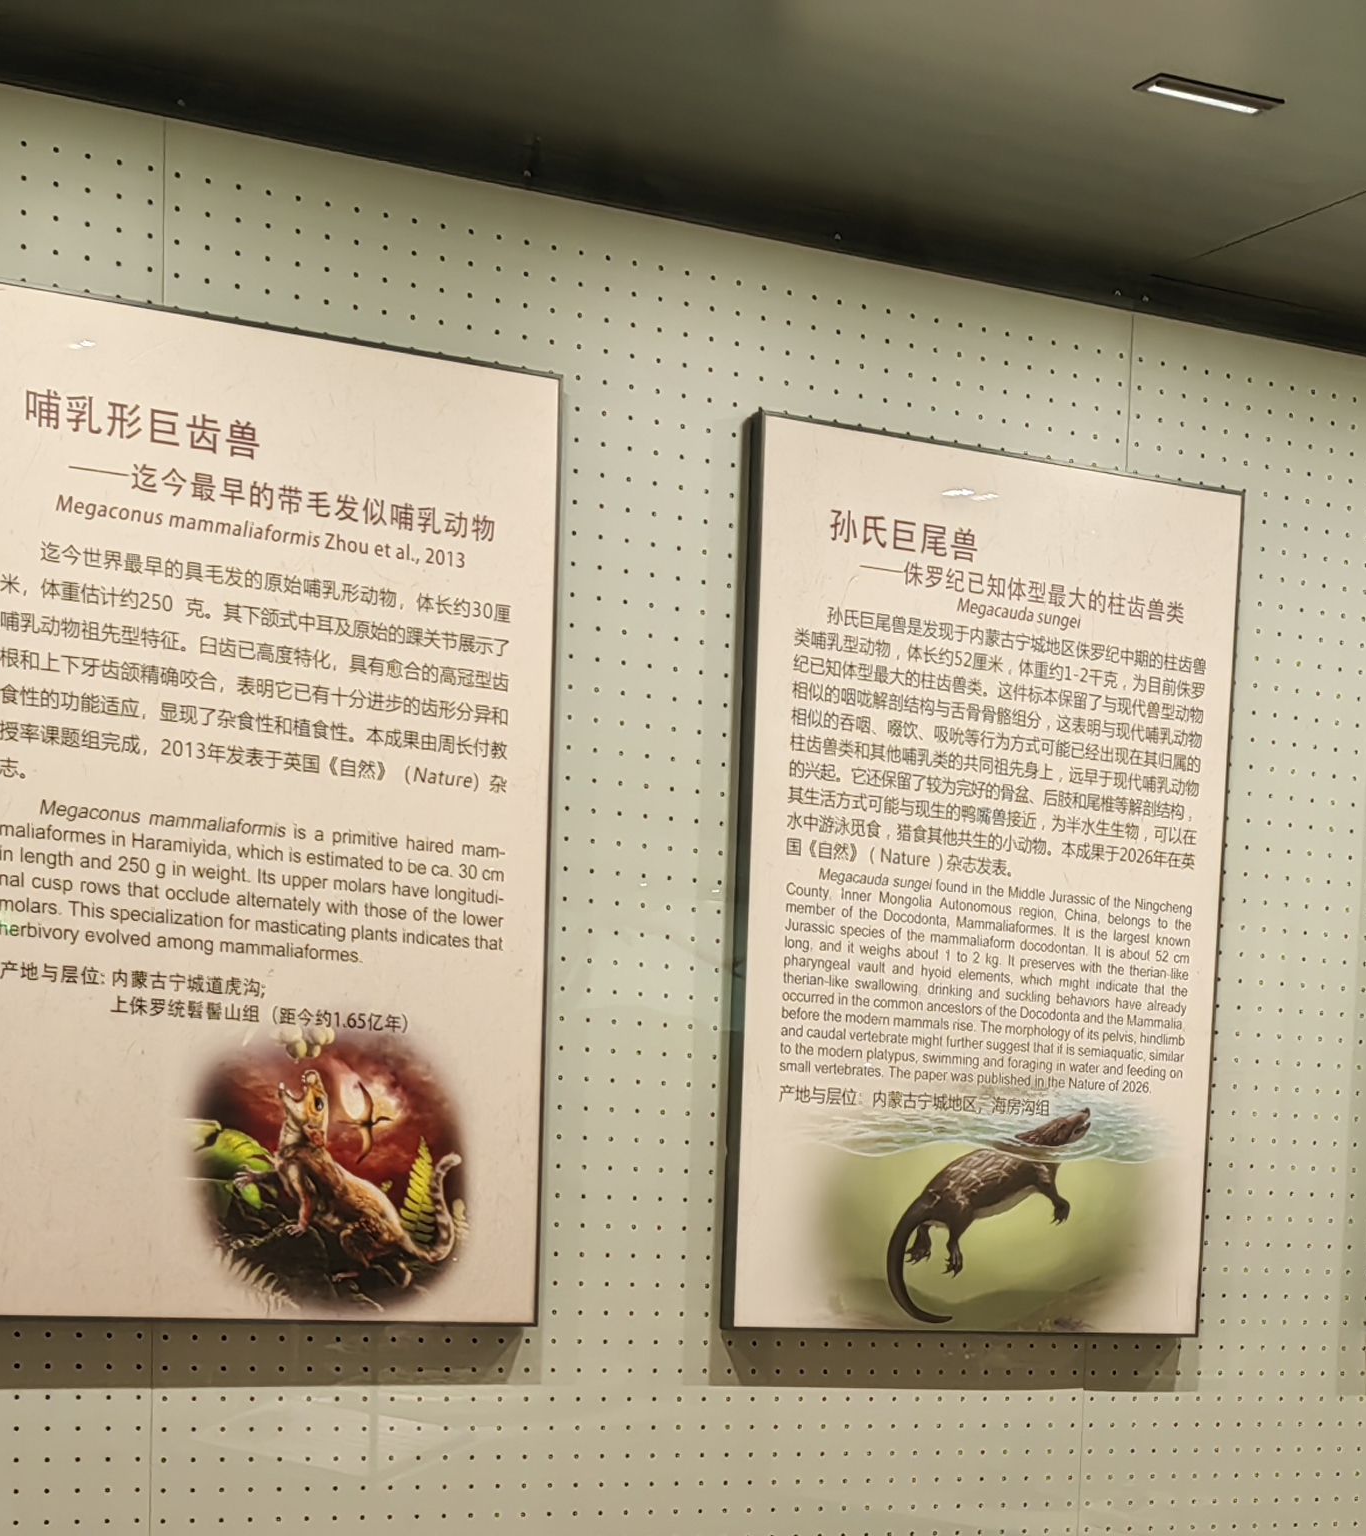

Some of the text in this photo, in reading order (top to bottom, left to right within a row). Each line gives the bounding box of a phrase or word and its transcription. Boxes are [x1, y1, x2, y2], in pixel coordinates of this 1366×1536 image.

[25, 388, 261, 461] 哺乳形巨齿兽
[55, 494, 466, 569] Megaconus mammaliaformis Zhou et al., 2013
[829, 508, 978, 563] 孙氏巨尾兽
[956, 597, 1082, 632] Megacauda sungei
[39, 798, 506, 859] Megaconus mammaliaformis is a primitive haired mam-
[20, 846, 74, 870] length
[79, 854, 112, 871] and
[117, 855, 150, 874] 250
[155, 862, 166, 880] g
[172, 860, 187, 877] in
[191, 864, 251, 885] weight.
[257, 867, 276, 886] Its
[281, 874, 329, 892] upper
[333, 877, 387, 895] molars
[391, 880, 430, 899] have
[434, 884, 505, 906] longitudi-
[818, 866, 1193, 918] Megacauda sungei found in the Middle Jurassic of the Ningcheng
[112, 968, 266, 999] 内蒙古宁城道虎沟;
[781, 1005, 820, 1022] before
[823, 1009, 842, 1023] the
[845, 1011, 890, 1026] modern
[892, 1016, 950, 1031] mammals
[980, 1019, 1003, 1035] The
[1004, 1023, 1072, 1042] morphology
[1073, 1027, 1085, 1040] of
[1086, 1027, 1100, 1041] its
[1139, 1031, 1186, 1047] hindlimb
